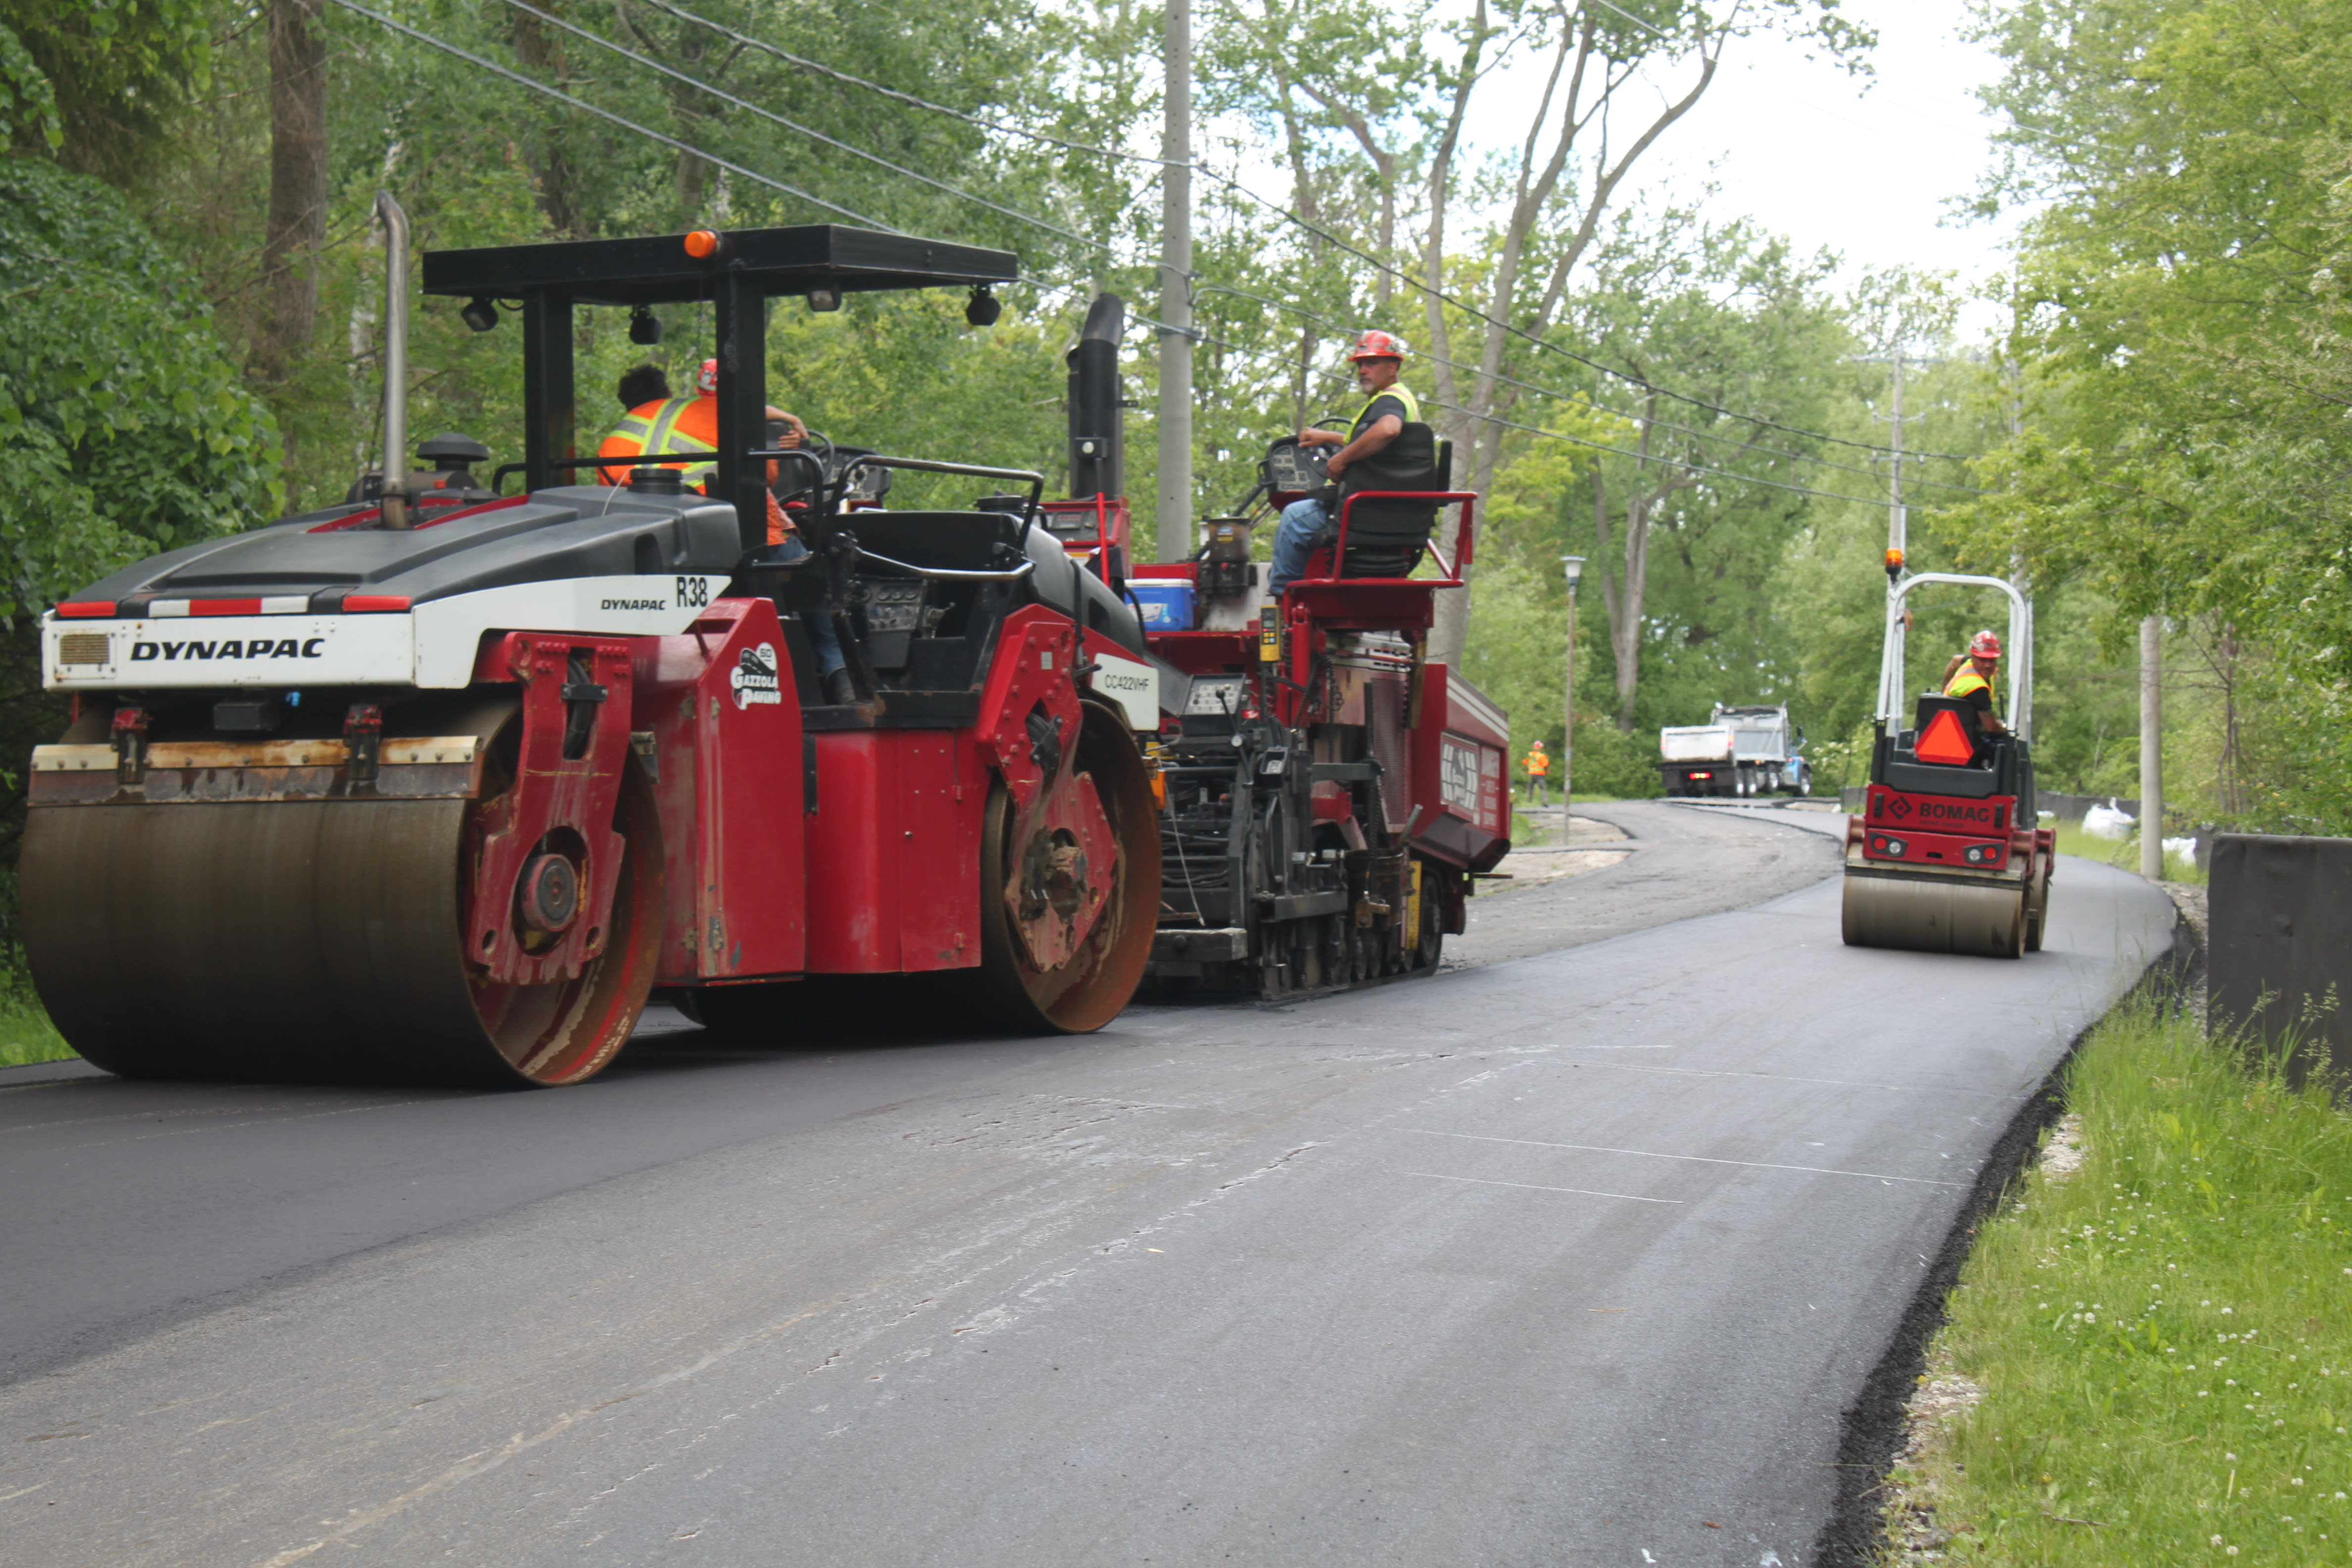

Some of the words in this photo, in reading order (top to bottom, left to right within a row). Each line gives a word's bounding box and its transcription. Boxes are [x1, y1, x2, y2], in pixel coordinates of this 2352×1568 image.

[676, 576, 707, 607] R38
[601, 599, 666, 610] DYNAPAC
[130, 638, 325, 661] DYNAPAC
[730, 666, 779, 689] GAZZOLA
[1919, 802, 1989, 822] BOMAG
